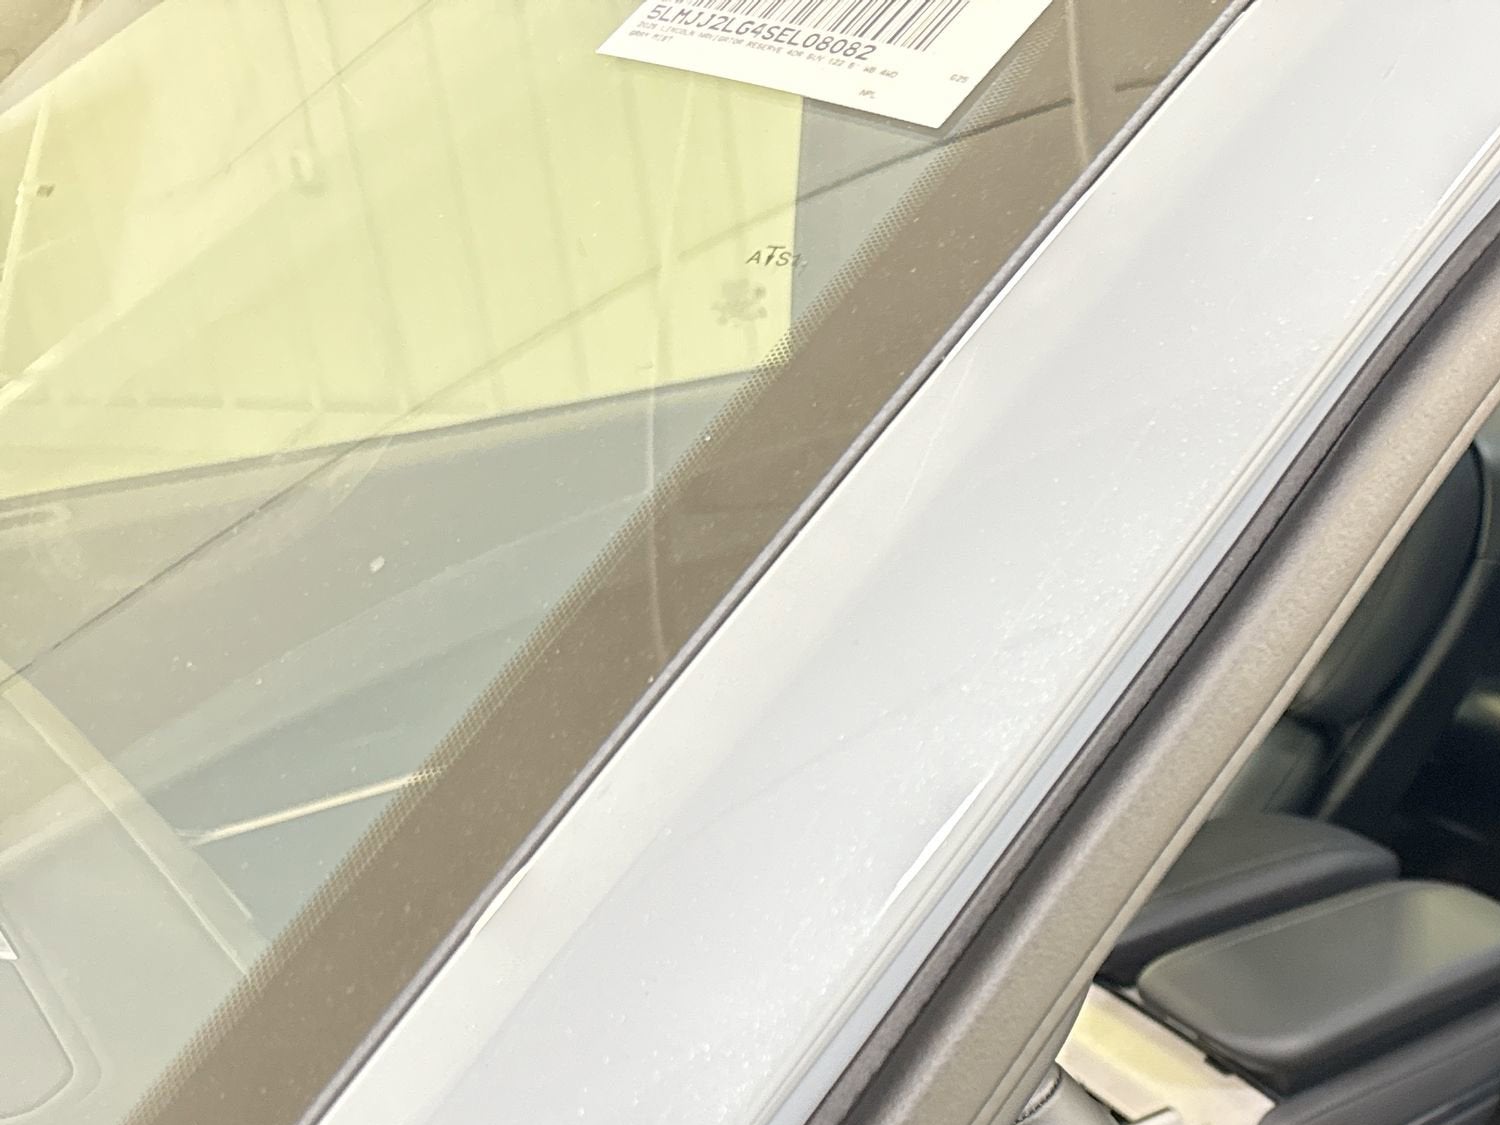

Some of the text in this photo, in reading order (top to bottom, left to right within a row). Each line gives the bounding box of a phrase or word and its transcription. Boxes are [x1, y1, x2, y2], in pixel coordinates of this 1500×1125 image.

[646, 4, 877, 61] 5LMJJ2LG4SEL08082
[660, 25, 695, 37] LINCOLN
[698, 32, 745, 45] NAVIGATOR
[745, 41, 783, 54] RESERVE
[880, 69, 899, 78] 4WD
